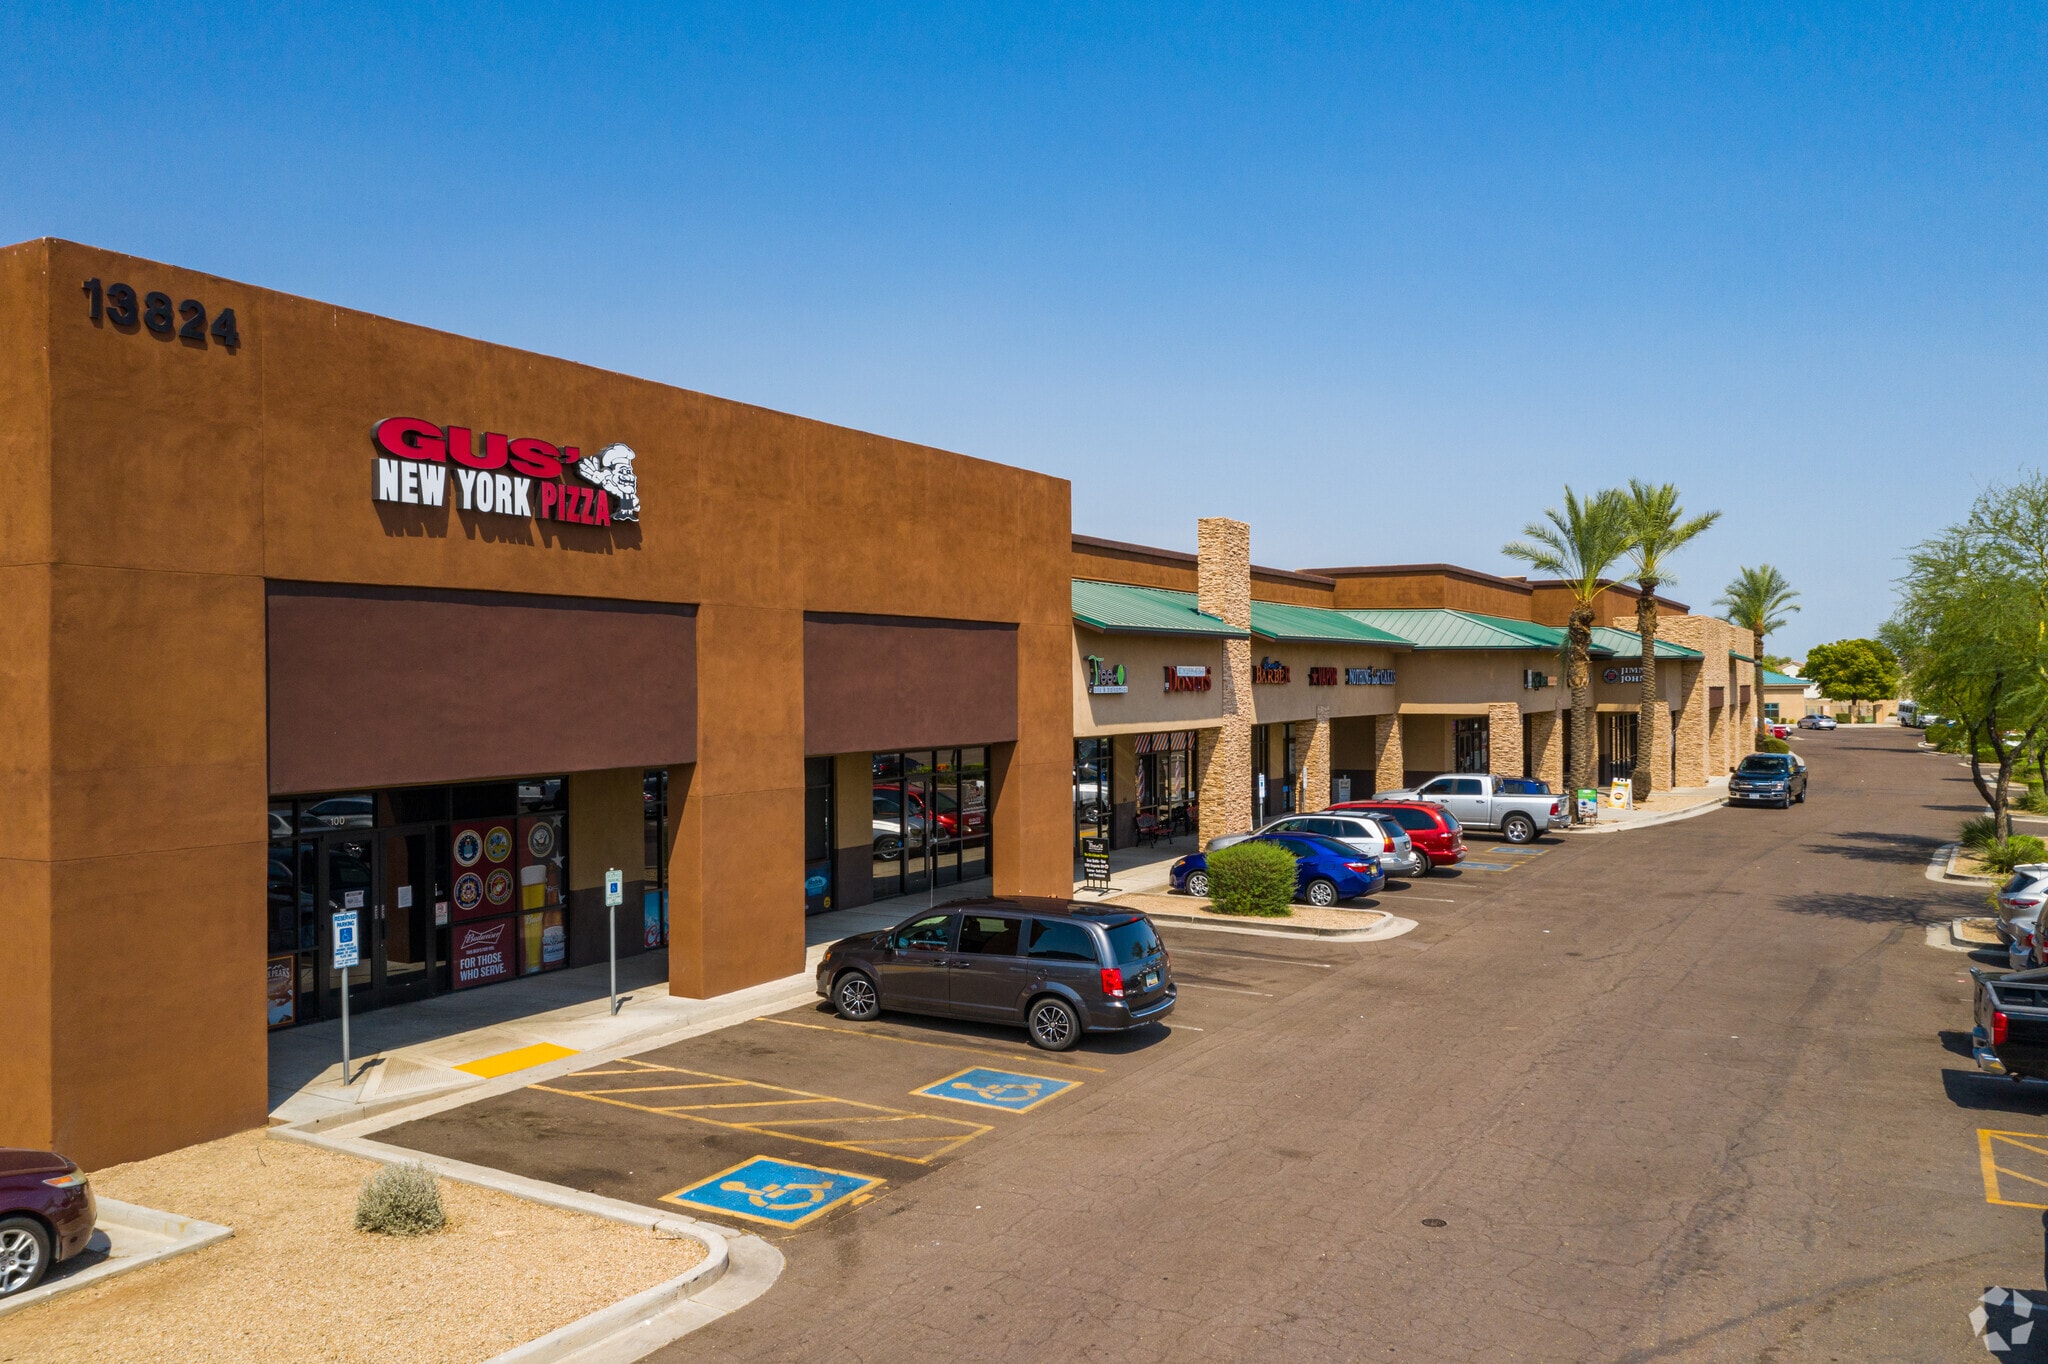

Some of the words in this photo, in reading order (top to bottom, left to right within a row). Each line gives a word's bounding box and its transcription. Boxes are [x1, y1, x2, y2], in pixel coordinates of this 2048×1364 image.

[81, 277, 239, 346] 13824
[376, 416, 580, 479] GUS'
[378, 457, 446, 507] NEW
[457, 468, 532, 517] YORK
[541, 480, 611, 527] PIZZA
[1255, 664, 1291, 685] BARBER
[1319, 667, 1338, 686] VAPOR
[330, 816, 345, 826] 100
[334, 913, 357, 921] RESERVED
[336, 920, 355, 928] PARKING
[464, 931, 501, 944] Budweiser
[460, 956, 477, 970] FOR
[477, 951, 503, 966] THOSE
[460, 968, 480, 982] WHO
[480, 962, 507, 978] SERVE.
